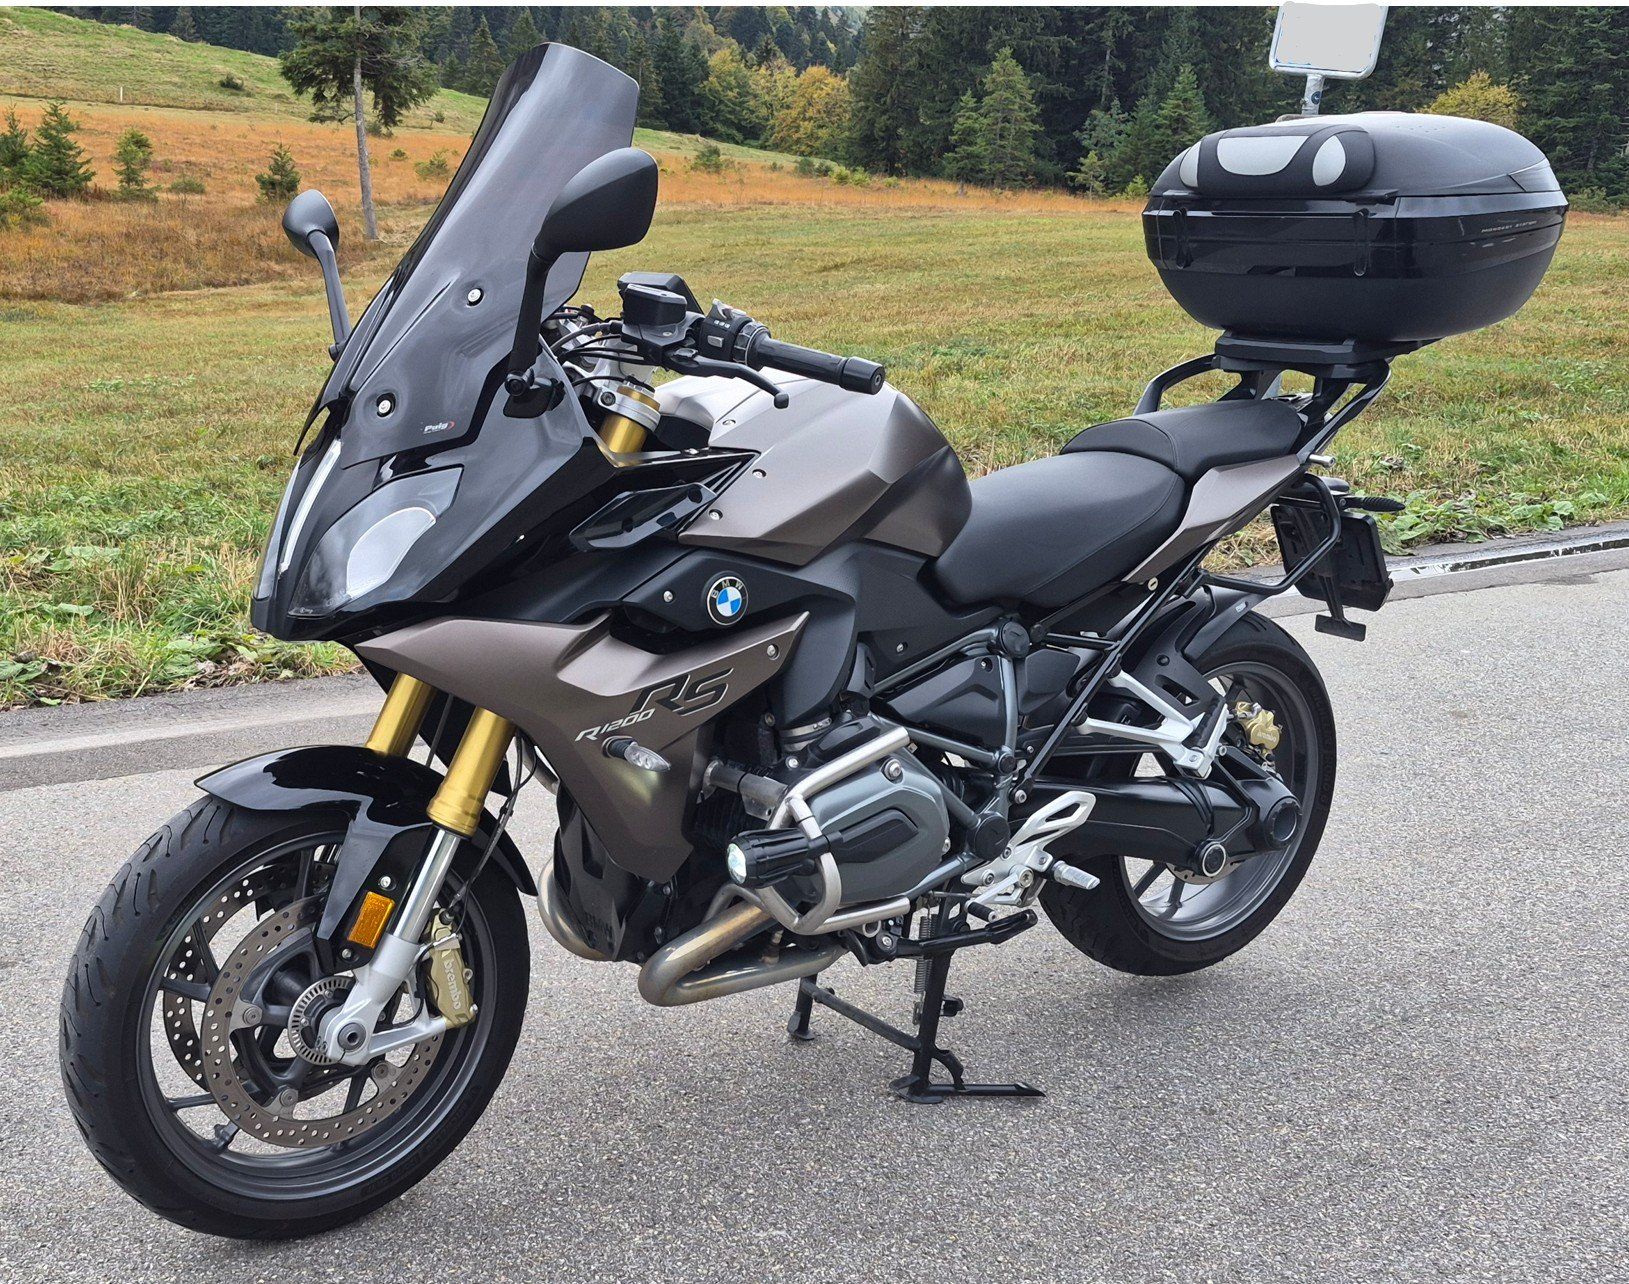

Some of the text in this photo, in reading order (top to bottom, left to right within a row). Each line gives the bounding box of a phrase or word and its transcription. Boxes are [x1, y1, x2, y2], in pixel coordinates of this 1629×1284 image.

[711, 580, 744, 599] BMW
[628, 667, 735, 717] RS
[574, 707, 655, 741] R1200
[443, 958, 462, 1010] brembo
